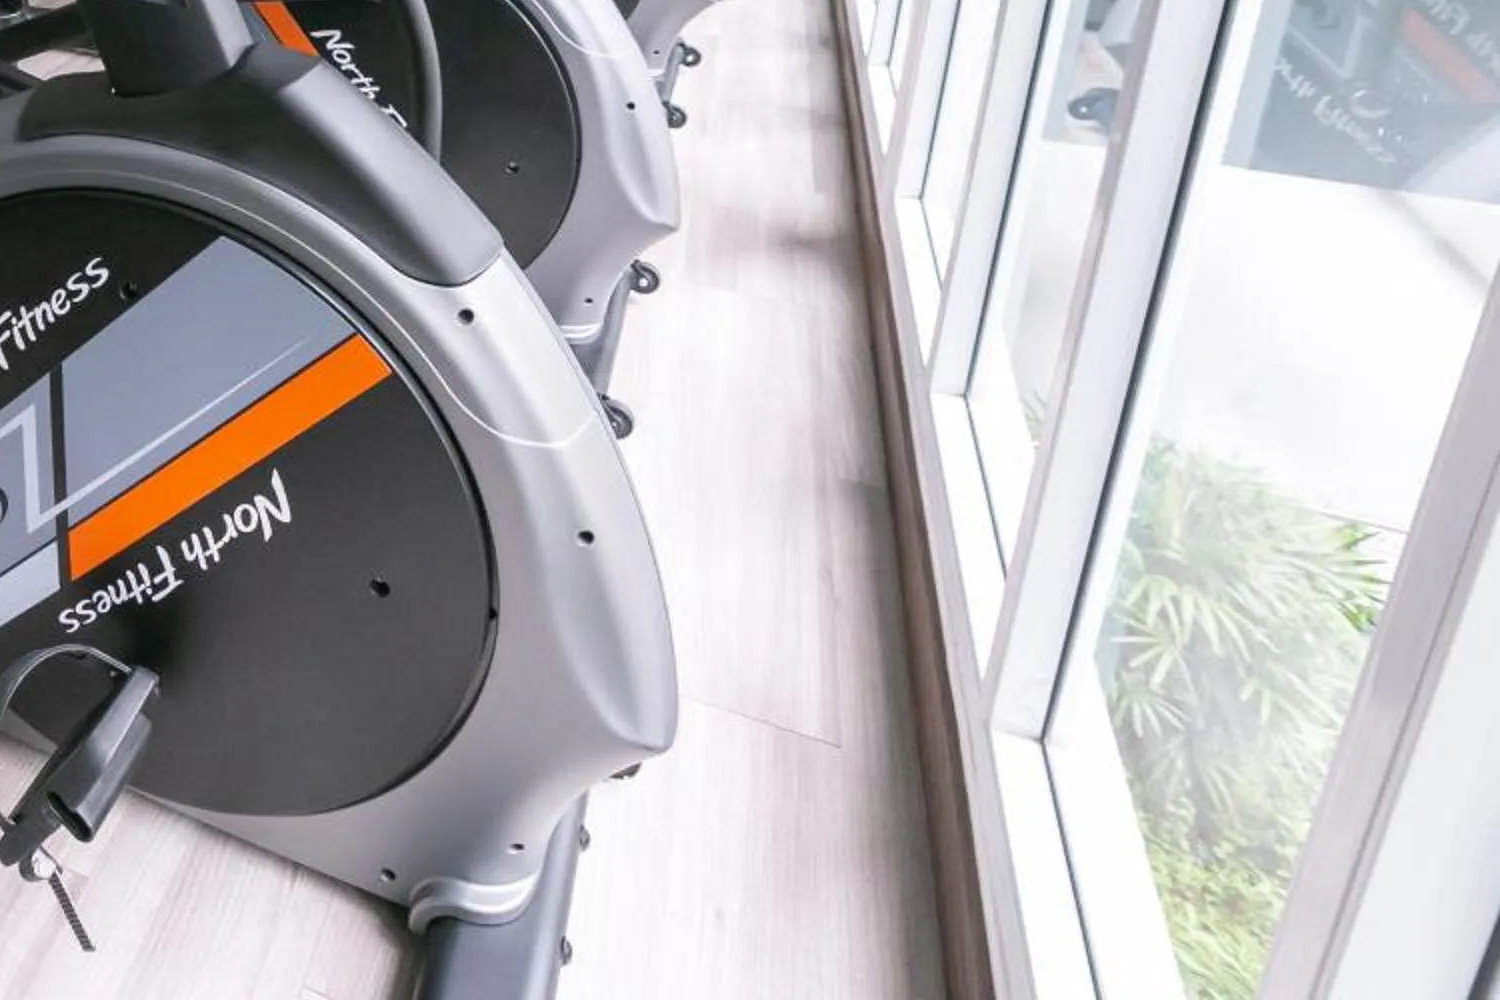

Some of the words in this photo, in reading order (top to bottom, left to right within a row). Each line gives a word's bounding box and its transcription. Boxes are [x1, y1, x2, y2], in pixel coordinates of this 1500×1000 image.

[309, 29, 381, 101] North
[180, 468, 292, 571] North
[58, 544, 184, 633] Fitness
